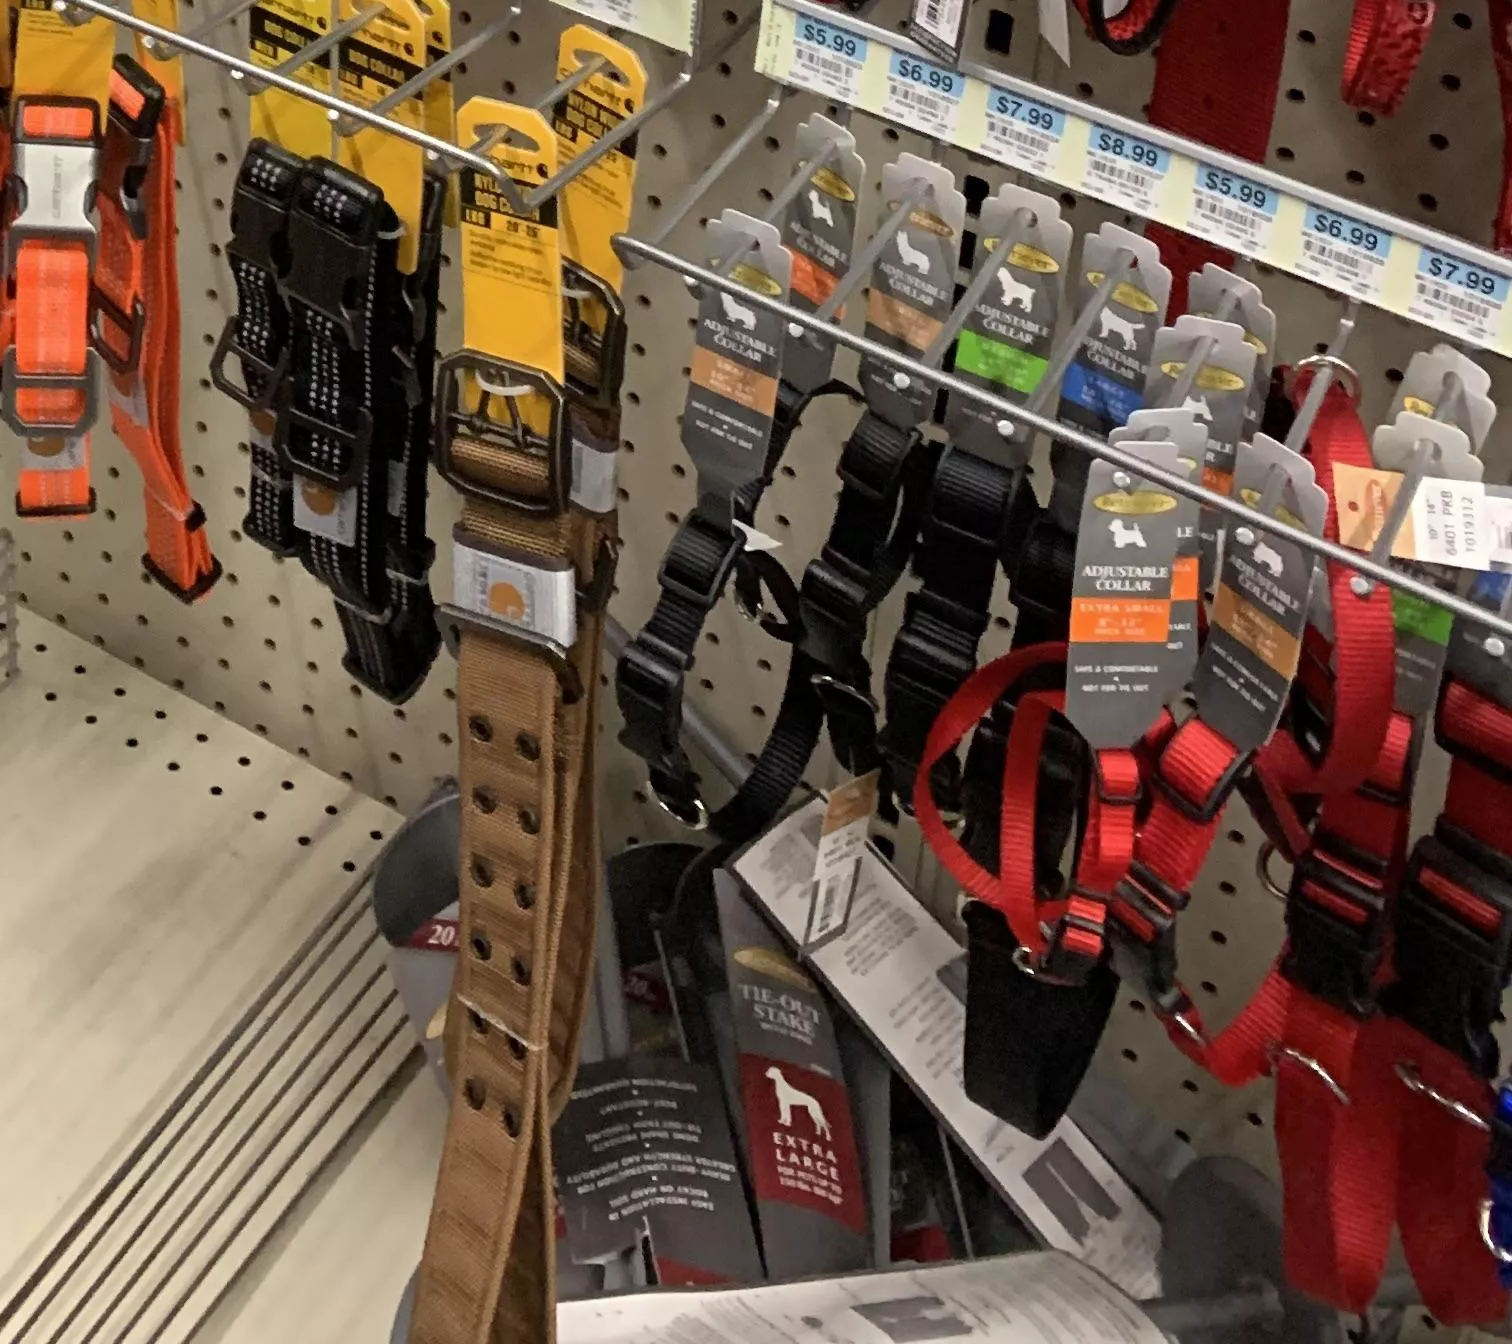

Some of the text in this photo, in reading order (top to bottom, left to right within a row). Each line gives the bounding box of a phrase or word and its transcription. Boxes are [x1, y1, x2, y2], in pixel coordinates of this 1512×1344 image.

[804, 23, 857, 57] $5.99
[898, 58, 954, 92] $6.99
[996, 95, 1055, 131] $7.99
[1098, 133, 1159, 168] $8.99
[1204, 171, 1266, 209] $5.99
[1313, 214, 1378, 252] $6.99
[878, 260, 949, 301] ADJUSTABLE
[1428, 256, 1496, 297] $7.99
[887, 277, 935, 308] COLLAR
[704, 316, 778, 358] ADJUSTABLE
[982, 316, 1035, 346] COLLAR
[713, 333, 763, 364] COLLAR
[1087, 351, 1136, 381] COLLAR
[1441, 490, 1454, 517] PKB
[1444, 523, 1458, 557] 6401
[1461, 496, 1477, 553] 1019312
[1081, 564, 1170, 579] ADJUSTABLE
[1095, 578, 1152, 592] COLLAR
[1079, 603, 1165, 614] EXTRA SMALL
[1074, 664, 1094, 674] SAFE
[1103, 664, 1159, 674] COMFORTABLE
[1081, 683, 1150, 693] NOT FOR TIE OUT
[427, 924, 456, 946] 20
[738, 983, 820, 1025] TIE-OUT
[753, 1004, 815, 1036] STAKE
[620, 1155, 641, 1167] AND
[642, 1151, 693, 1163] STRENGTH
[772, 1131, 837, 1164] EXTRA
[566, 1162, 619, 1185] DURABILITY
[596, 1162, 669, 1189] CONSTRUCTION
[775, 1148, 840, 1182] LARGE
[576, 1183, 596, 1195] FOR
[608, 1184, 709, 1209] ROCKY OR HARD SOIL
[608, 1195, 715, 1222] EASY INSTALLATION IN
